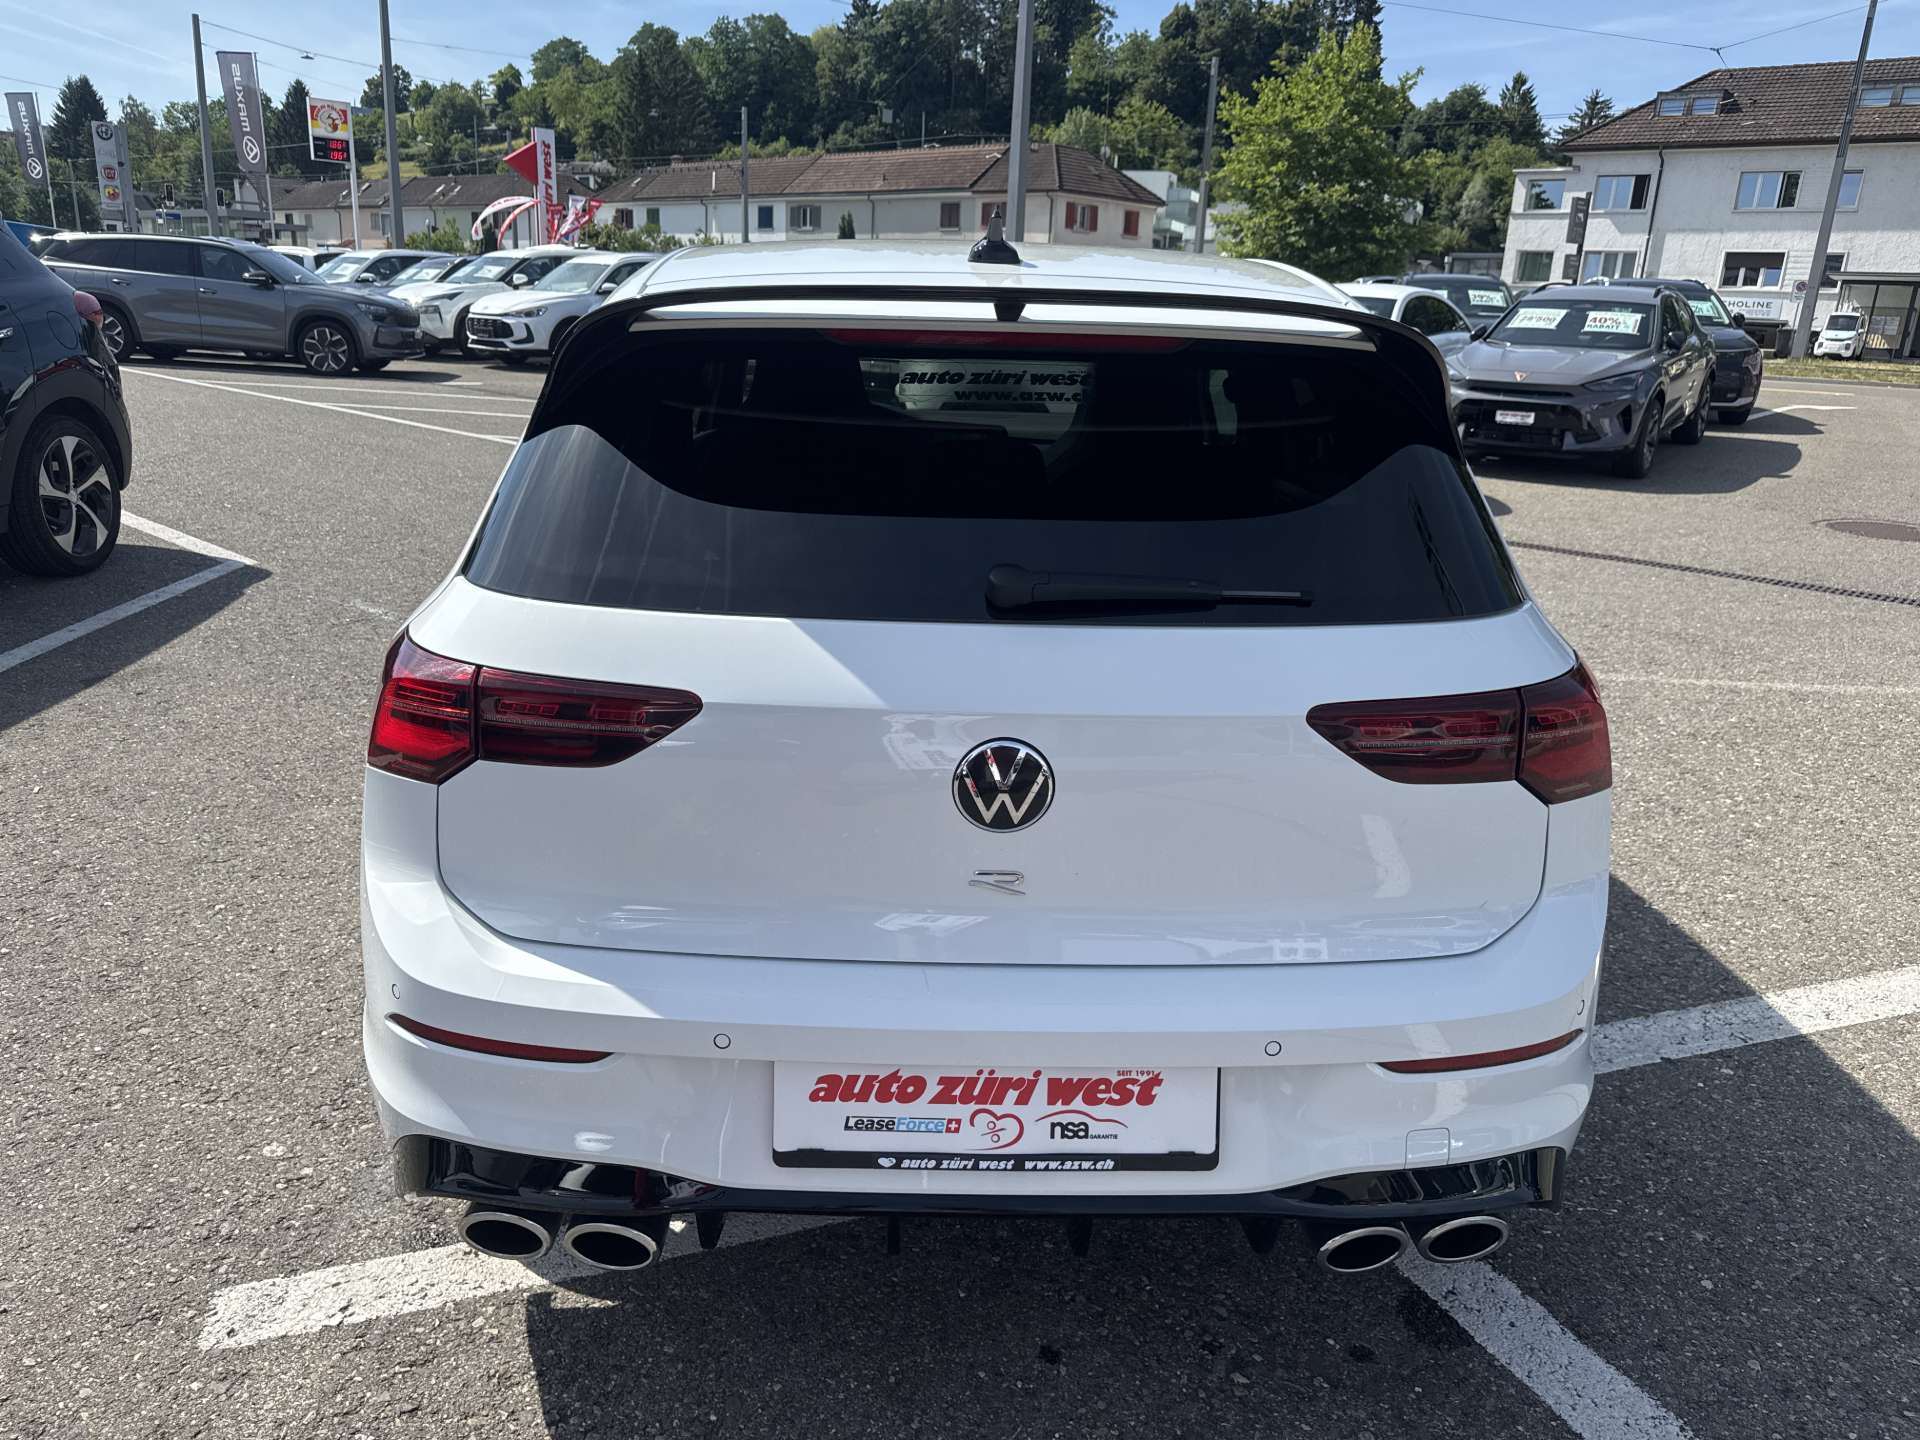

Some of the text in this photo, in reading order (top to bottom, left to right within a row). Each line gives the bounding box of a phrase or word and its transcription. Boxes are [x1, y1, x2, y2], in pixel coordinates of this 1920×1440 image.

[542, 141, 552, 179] west
[1589, 316, 1621, 325] 40%
[901, 370, 966, 385] auto
[966, 370, 1027, 385] züri
[808, 1068, 1164, 1107] auto züri west
[844, 1116, 945, 1133] LeaseForce
[1050, 1121, 1089, 1140] nsa
[900, 1157, 1115, 1170] auto züri west www.azw.ch
